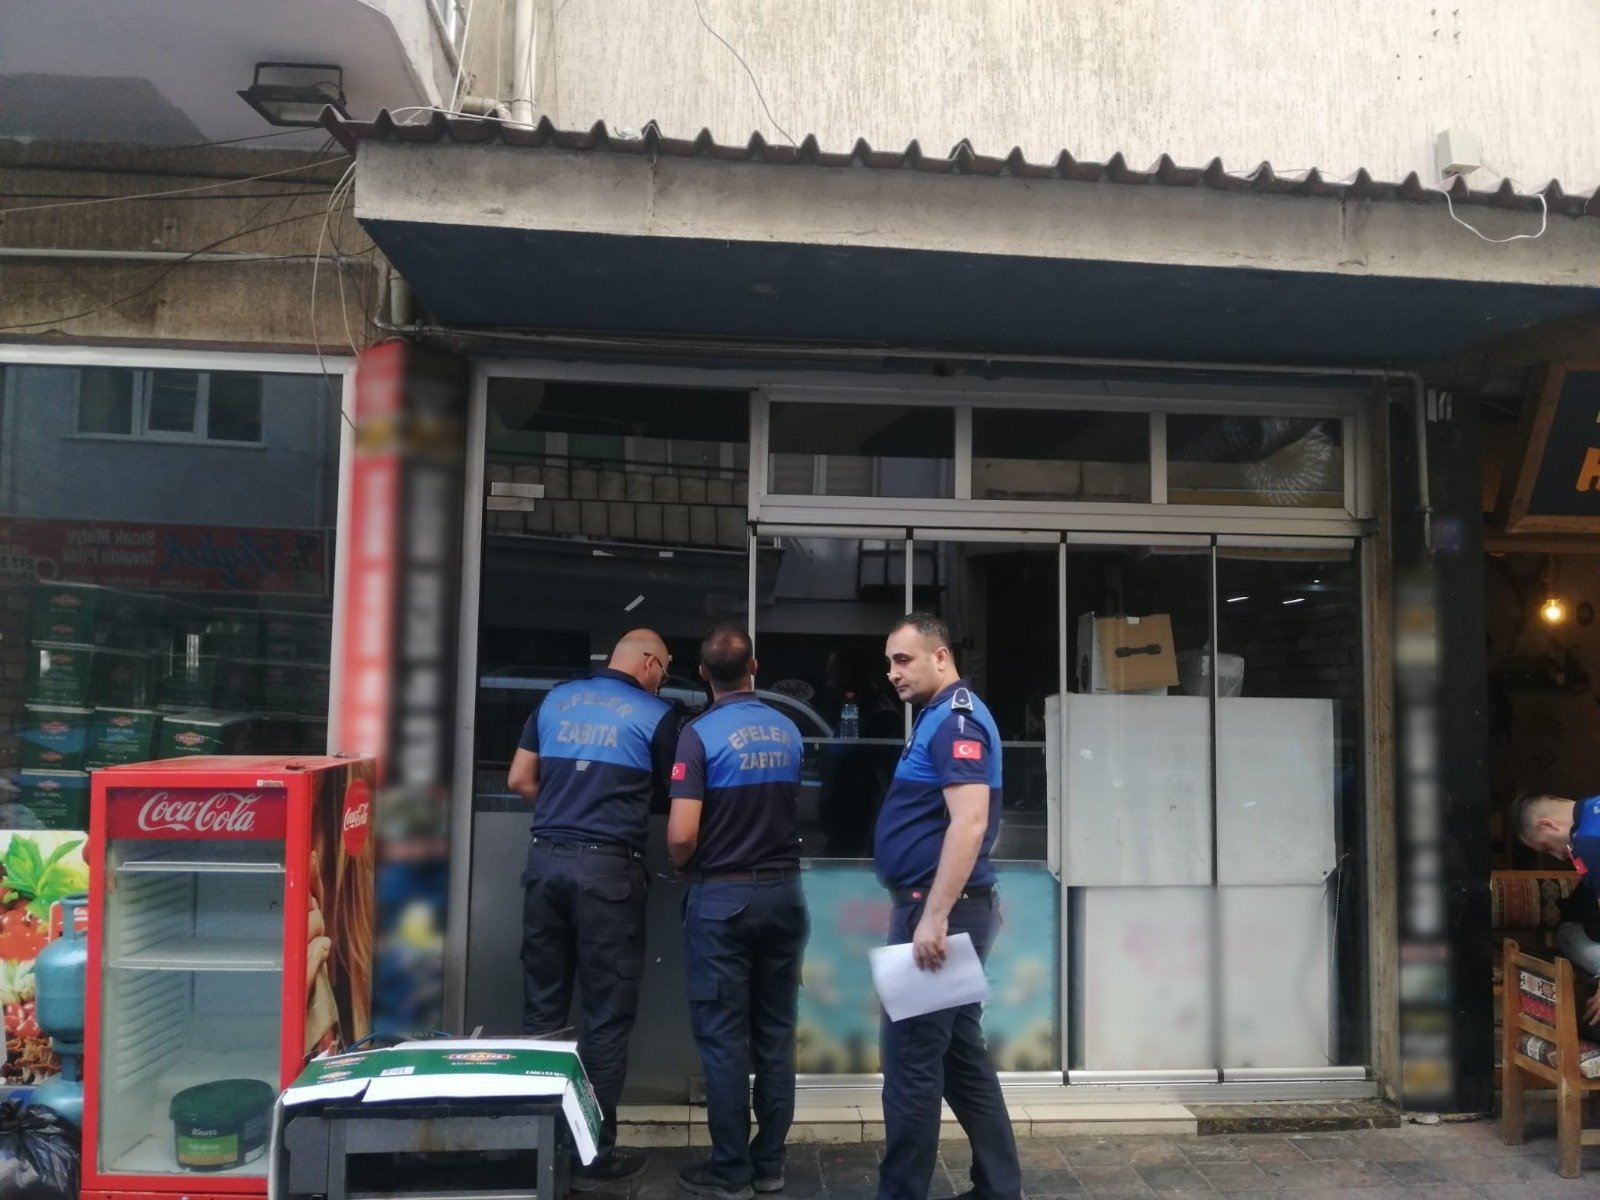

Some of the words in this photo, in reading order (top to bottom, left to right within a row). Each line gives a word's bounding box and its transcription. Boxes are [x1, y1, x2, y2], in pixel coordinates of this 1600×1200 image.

[556, 720, 618, 748] ZABITA
[739, 751, 791, 771] ZABITA
[137, 791, 261, 832] Coca-Cola
